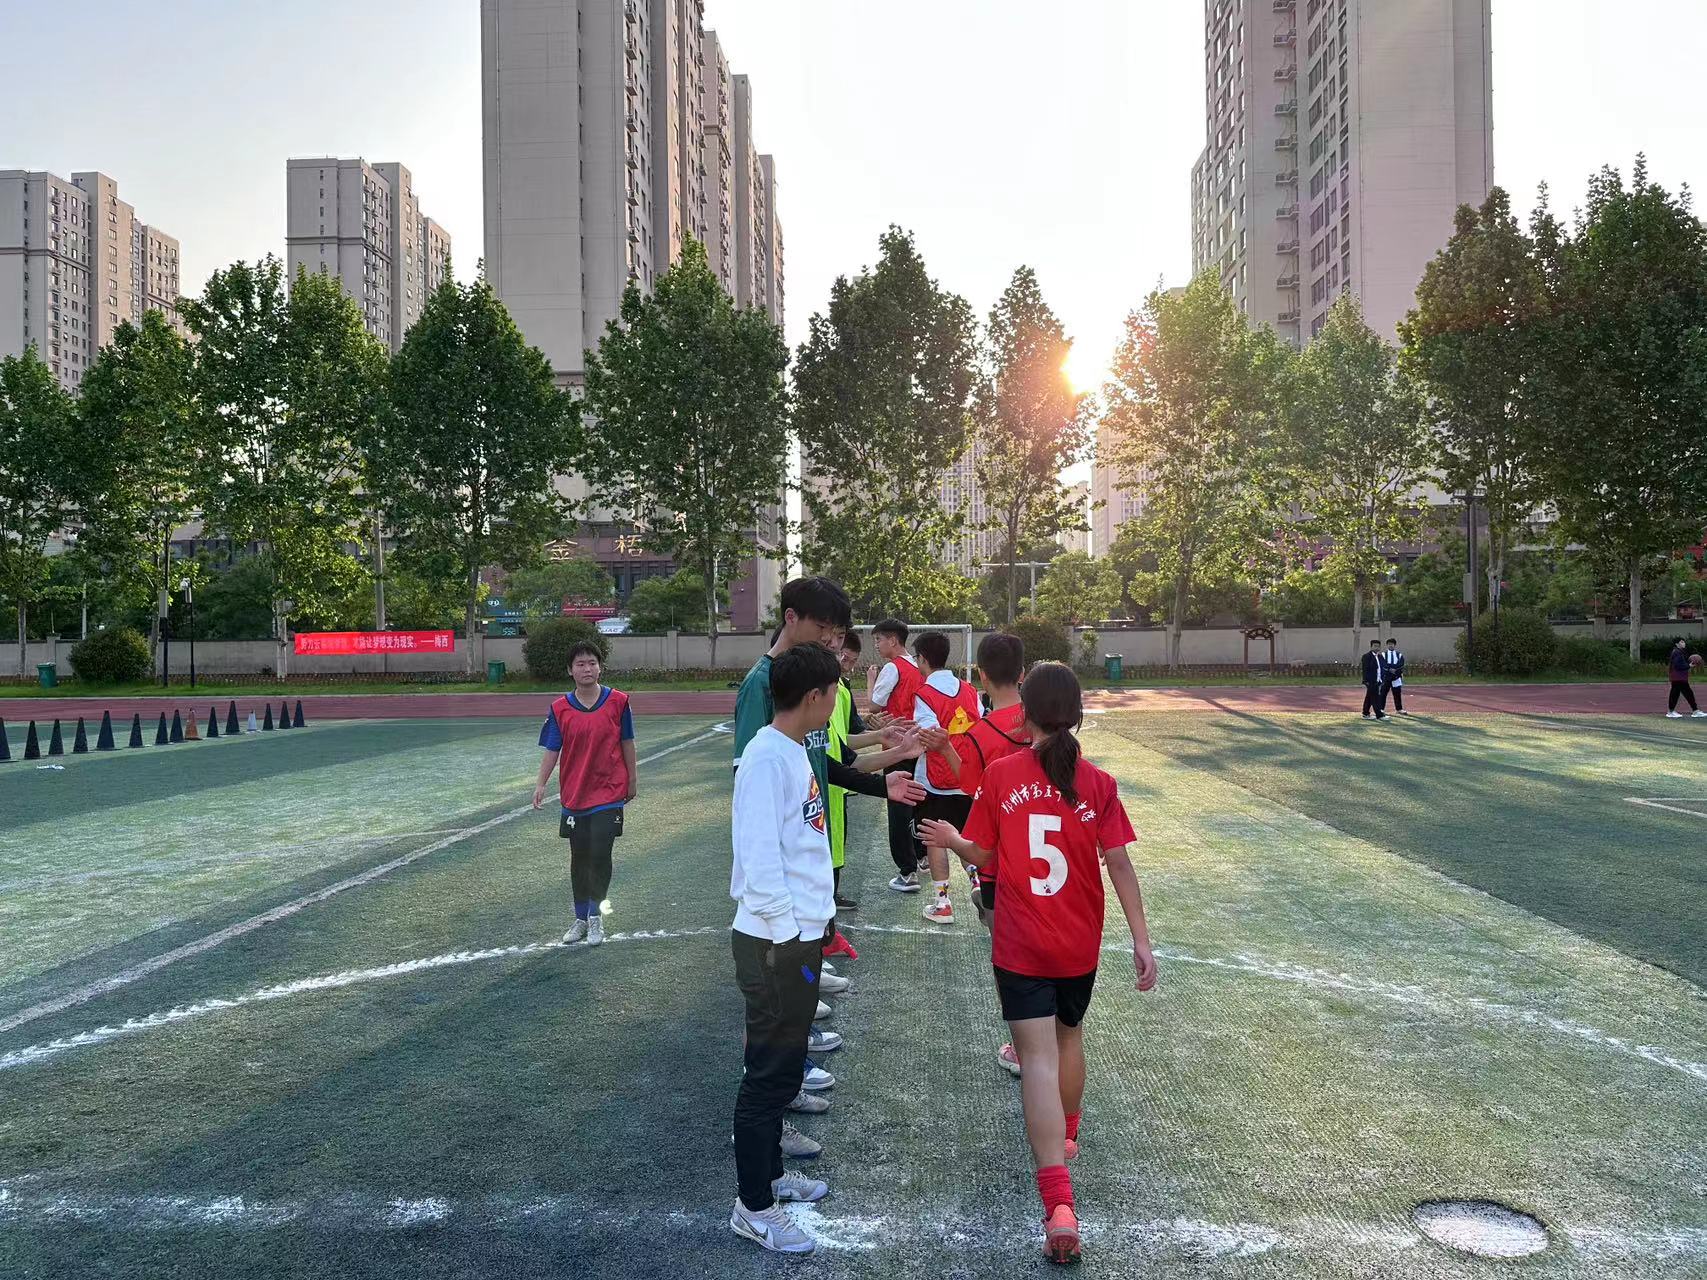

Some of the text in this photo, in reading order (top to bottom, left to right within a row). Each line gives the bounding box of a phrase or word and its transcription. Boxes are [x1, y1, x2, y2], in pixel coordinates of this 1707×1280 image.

[566, 815, 576, 829] 4
[1000, 781, 1097, 822] 郑州市第五中学
[1028, 813, 1069, 897] 5
